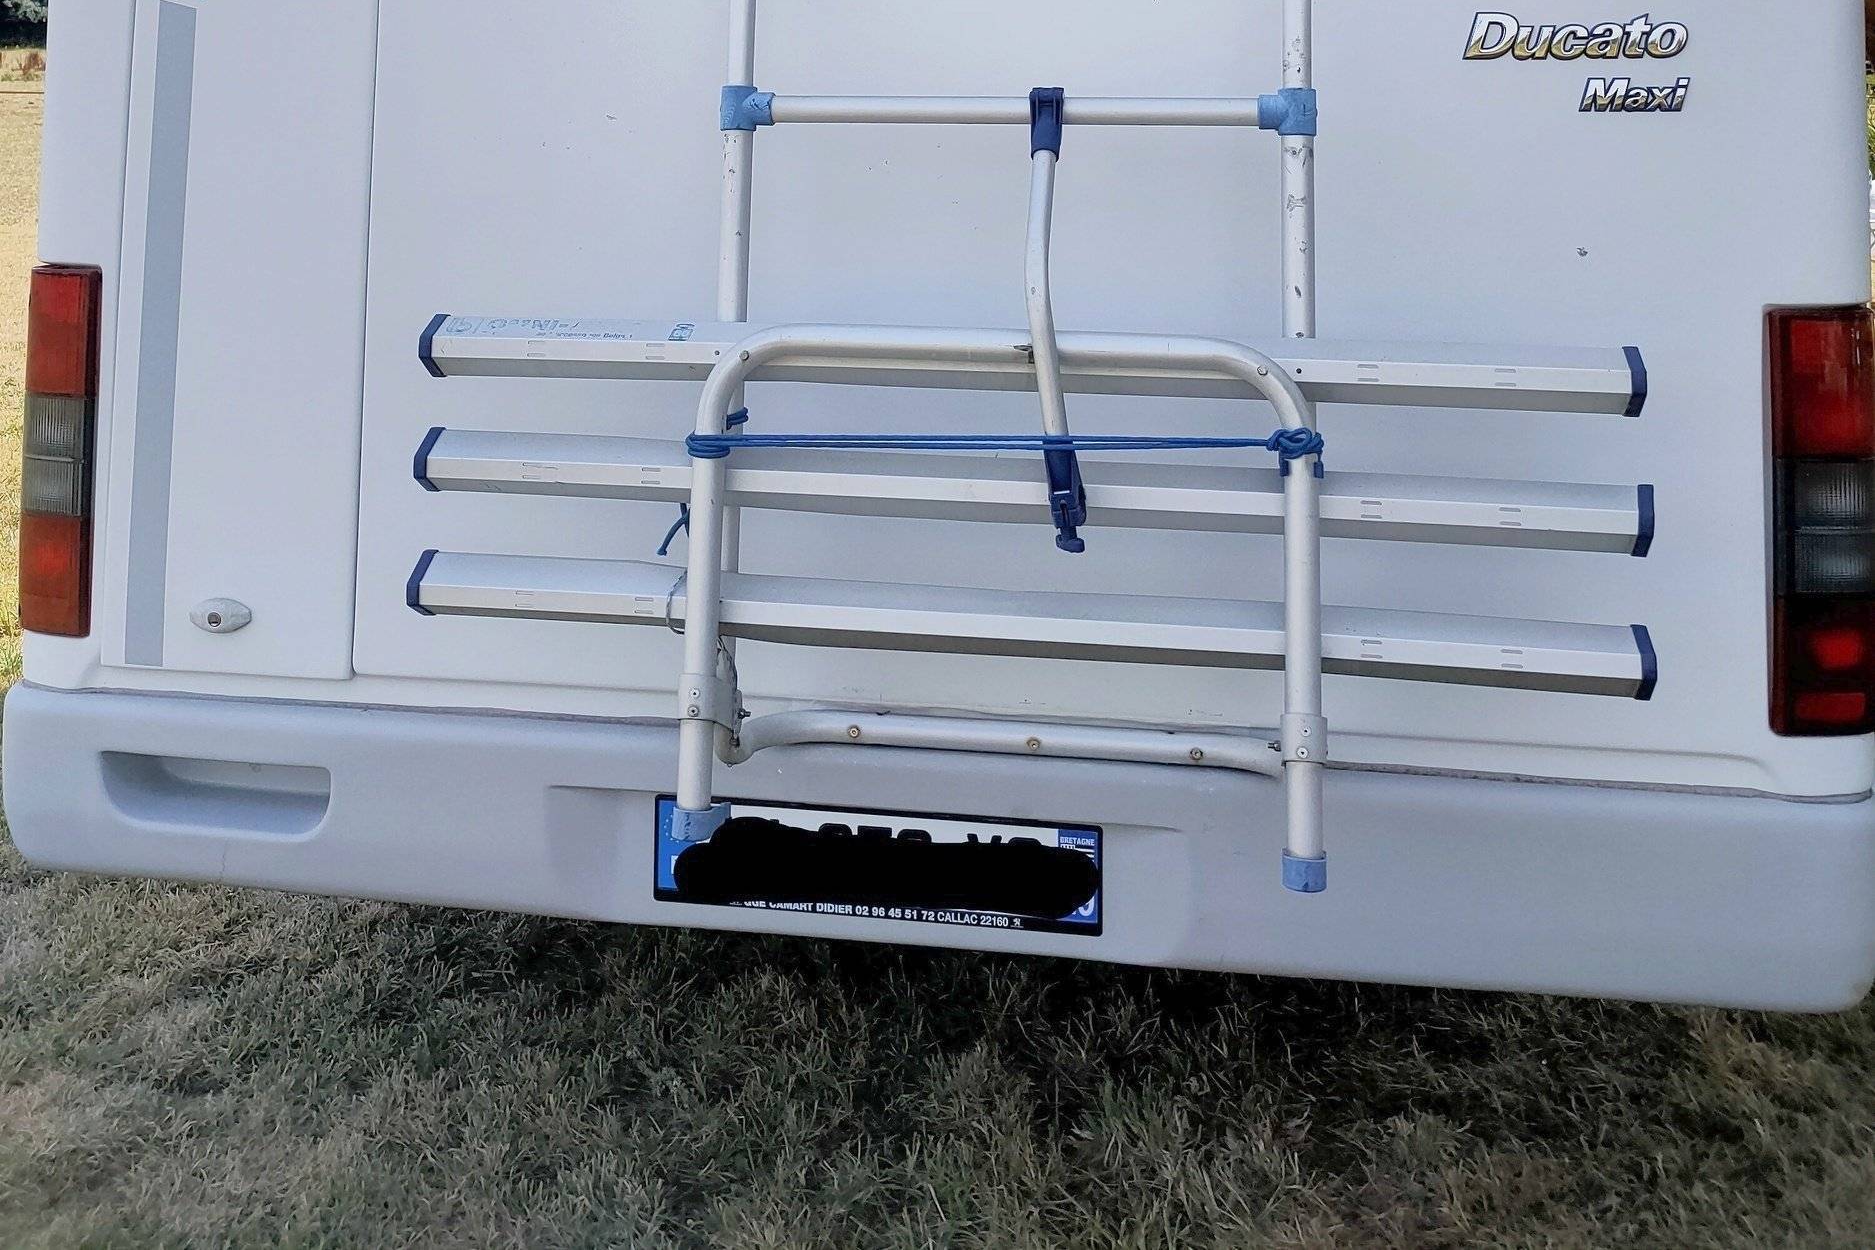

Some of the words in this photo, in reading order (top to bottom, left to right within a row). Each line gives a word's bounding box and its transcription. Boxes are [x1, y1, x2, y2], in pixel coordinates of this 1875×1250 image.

[1462, 11, 1689, 61] Ducato
[1578, 77, 1691, 113] Maxi
[1060, 836, 1095, 847] BRETAGNE
[769, 901, 814, 912] CAMART
[816, 902, 853, 915] DIDIER
[855, 905, 869, 916] 02
[872, 906, 886, 917] 96
[888, 907, 902, 918] 45
[905, 909, 918, 920] 51
[921, 910, 935, 921] 72
[937, 911, 979, 925] CALLAC
[980, 915, 1009, 927] 22160
